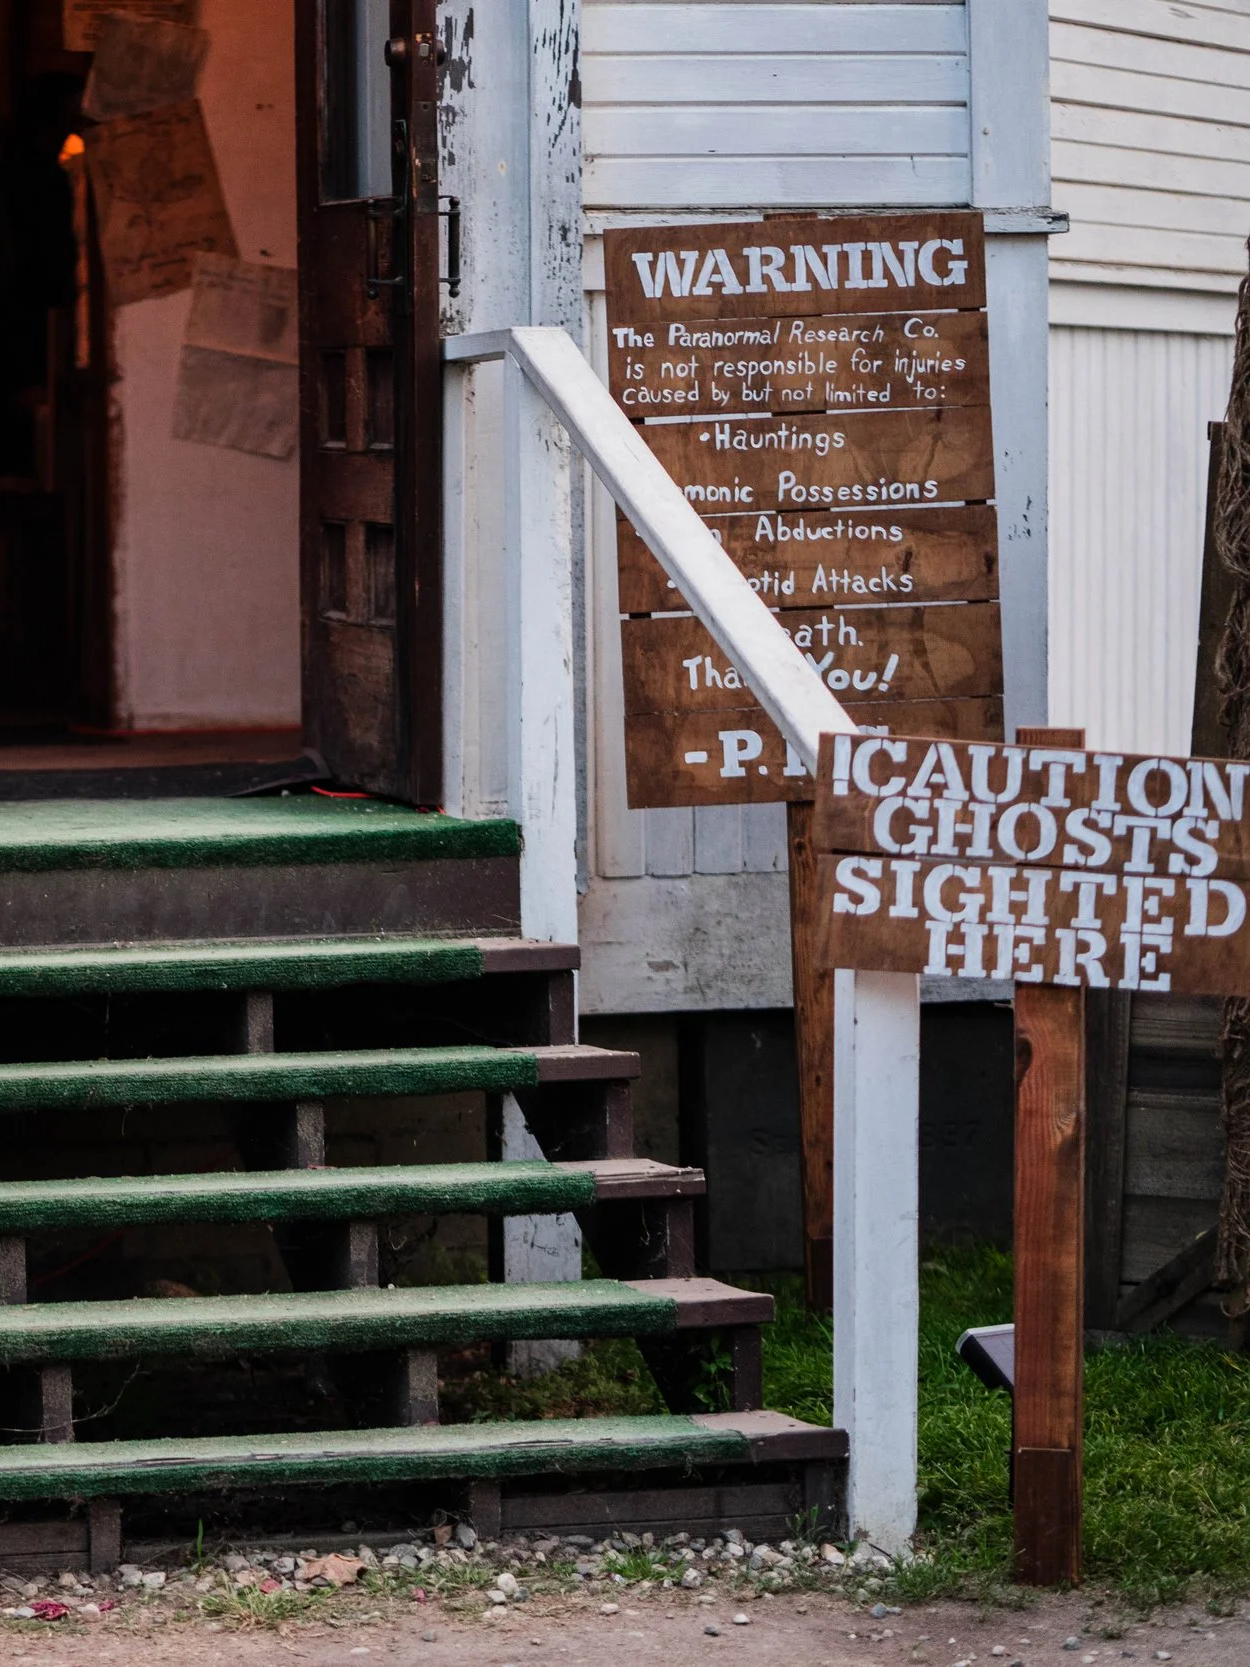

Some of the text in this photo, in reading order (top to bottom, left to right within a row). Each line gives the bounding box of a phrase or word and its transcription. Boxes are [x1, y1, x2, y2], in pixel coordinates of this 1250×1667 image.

[632, 238, 968, 298] WARNING
[613, 317, 940, 348] The Paranormal Research Co.
[626, 347, 966, 384] is not responsible for injuries
[622, 380, 946, 406] caused by but not limited to:
[713, 422, 846, 456] Hauntings
[681, 470, 939, 503] monic Possessions
[755, 515, 903, 543] Abductions
[811, 563, 913, 593] Attacks
[682, 652, 899, 692] Tha You!
[873, 796, 1220, 877] GHOSTS
[833, 857, 1247, 937] SIGHTED
[923, 920, 1172, 992] HERE
